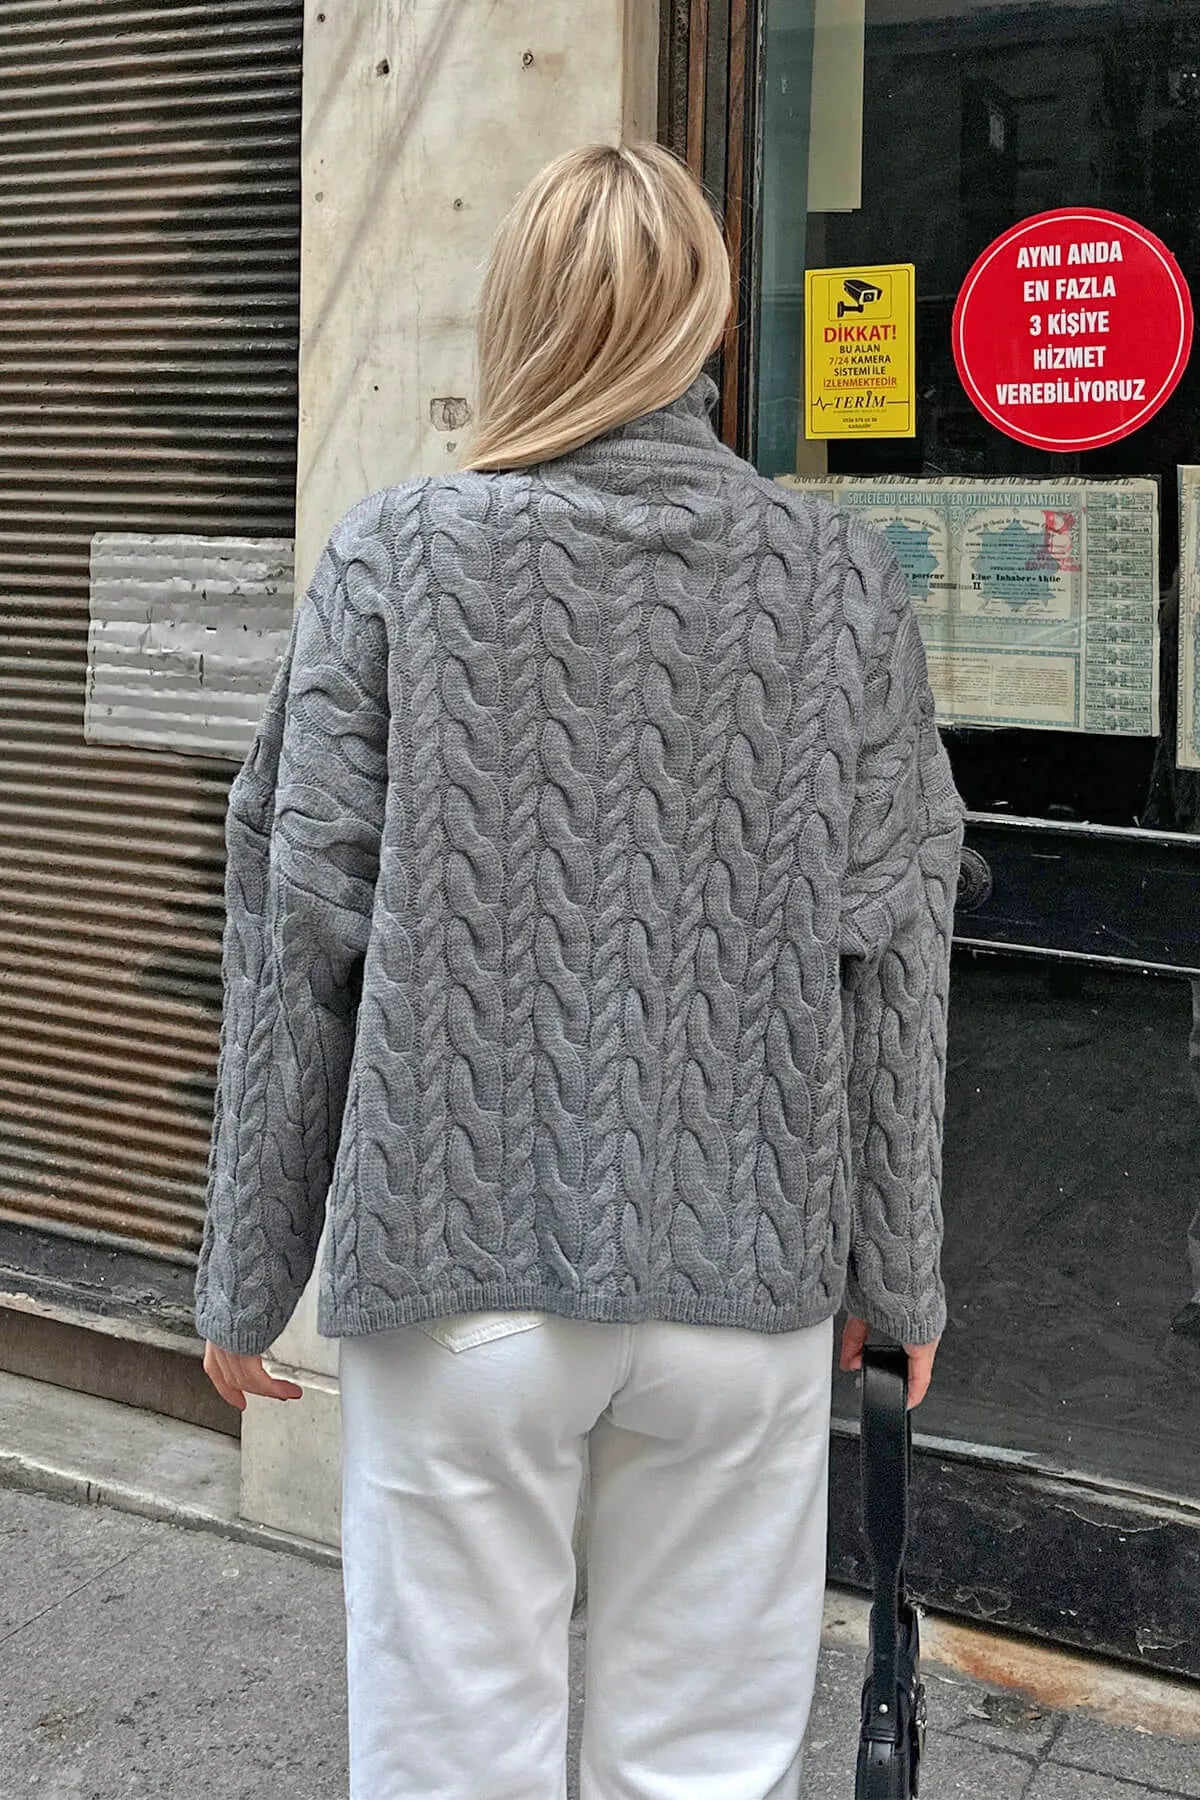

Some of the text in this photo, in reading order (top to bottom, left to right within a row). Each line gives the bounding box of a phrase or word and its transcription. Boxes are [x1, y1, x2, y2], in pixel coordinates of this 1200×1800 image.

[1017, 240, 1123, 268] AYNI ANDA
[1024, 276, 1116, 302] EN FAZLA
[1029, 308, 1109, 336] 3 KİŞİYE
[824, 323, 896, 343] DİKKAT!
[840, 344, 880, 353] BU ALAN
[1033, 344, 1107, 370] HİZMET
[829, 355, 891, 365] 7/24 KAMERA
[834, 365, 886, 376] SİSTEMİ İLE
[824, 376, 896, 388] İZLENMEKTEDİR
[996, 377, 1145, 405] VEREBİLİYORUZ
[898, 493, 931, 504] CHEMIN
[966, 493, 1011, 505] OTTOMAN
